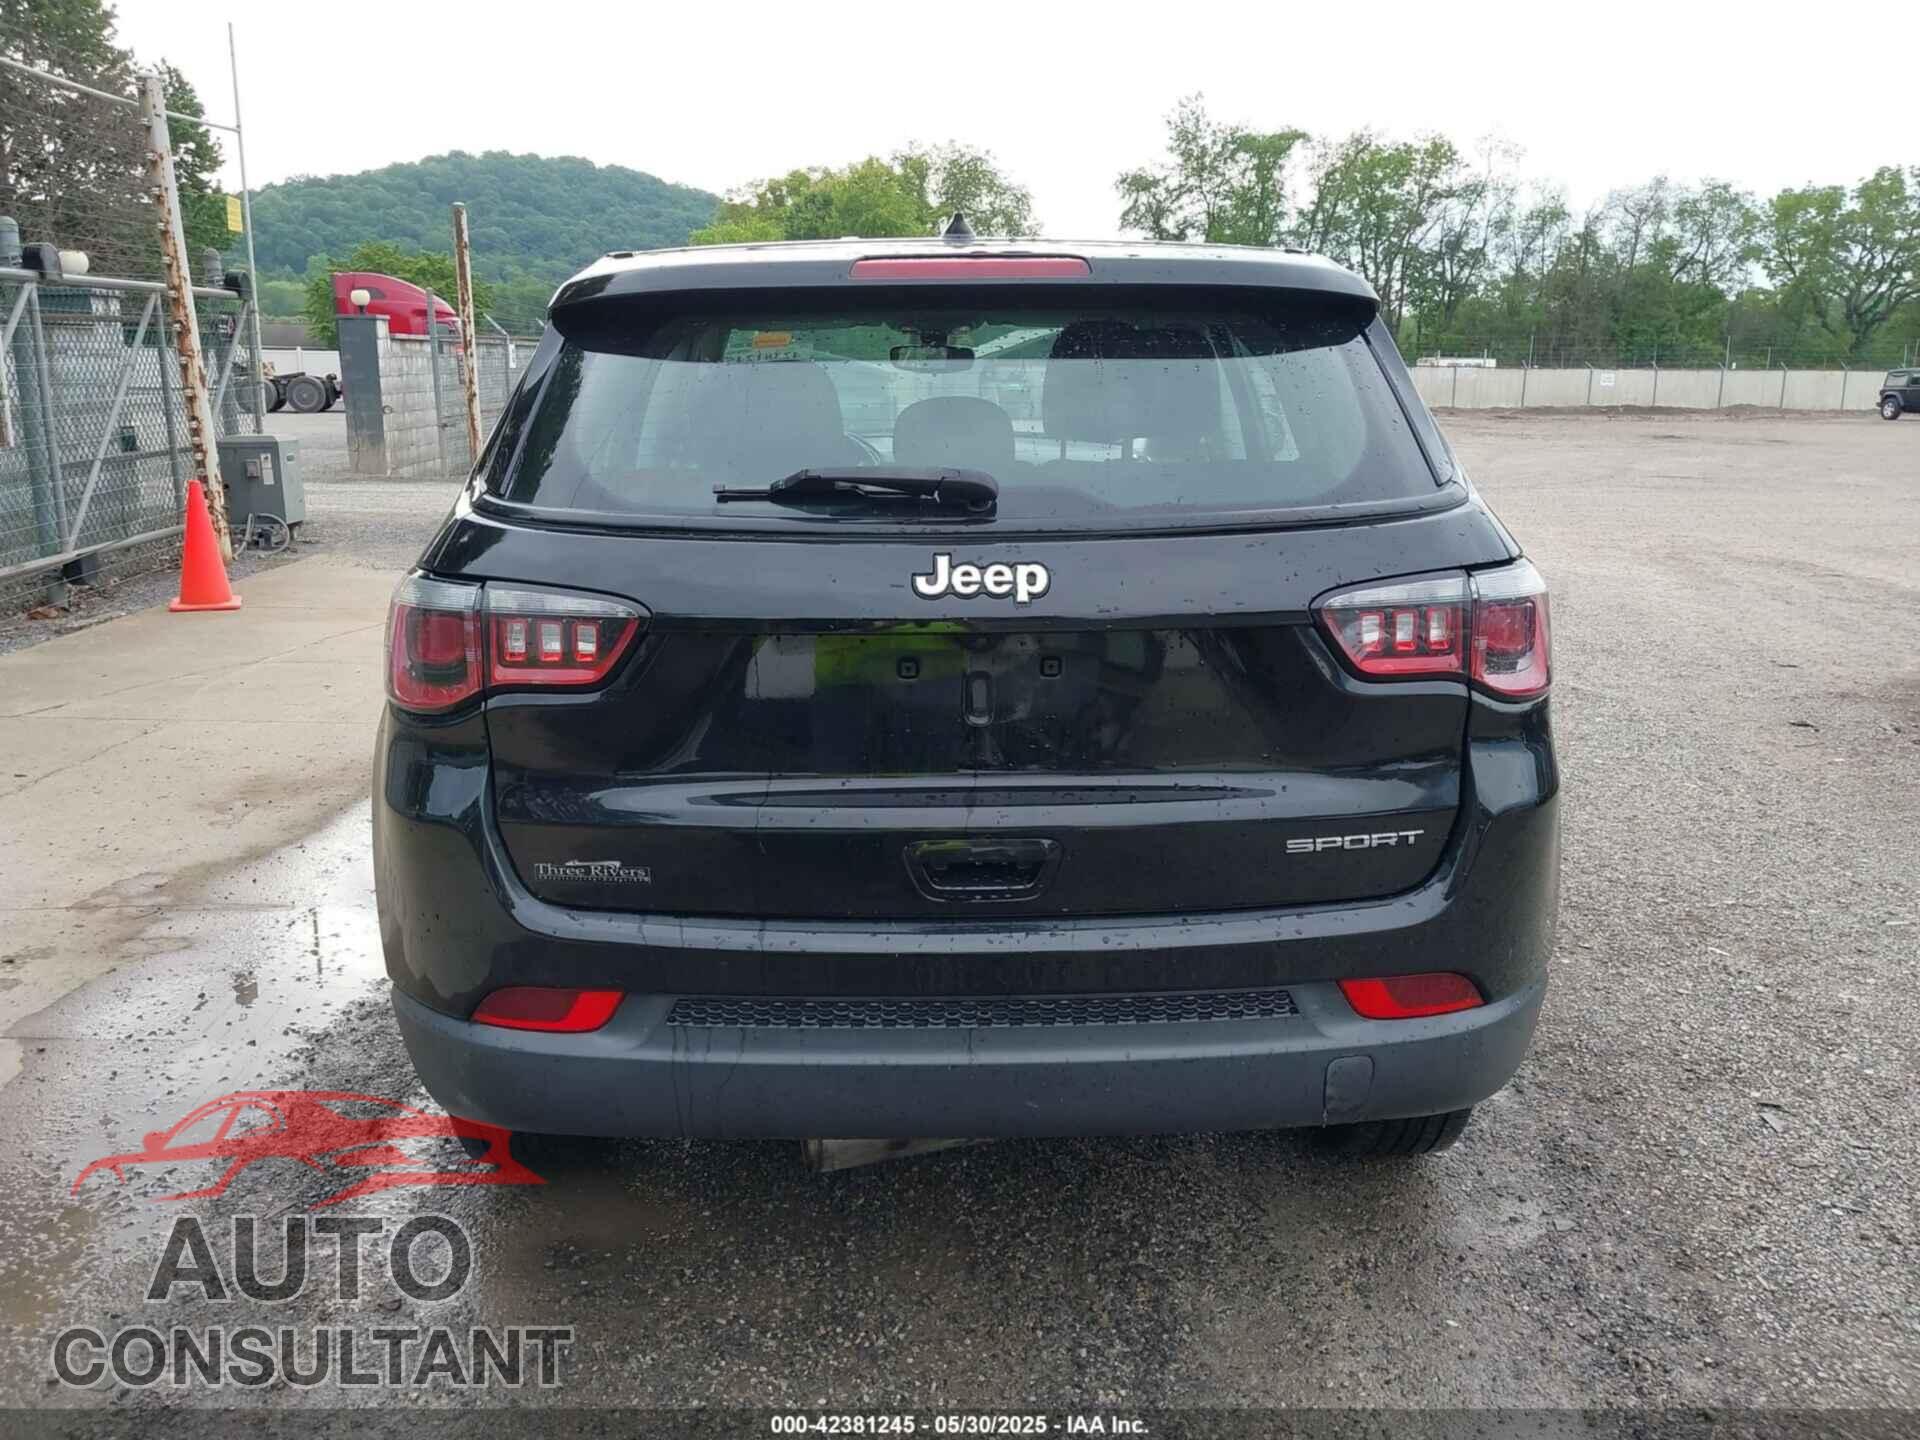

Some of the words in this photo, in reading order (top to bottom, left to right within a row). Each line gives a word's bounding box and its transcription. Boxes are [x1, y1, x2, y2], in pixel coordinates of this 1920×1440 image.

[914, 554, 1050, 603] Jeep
[1285, 829, 1425, 854] SPORT
[537, 863, 585, 876] Three
[591, 863, 646, 877] Rivers
